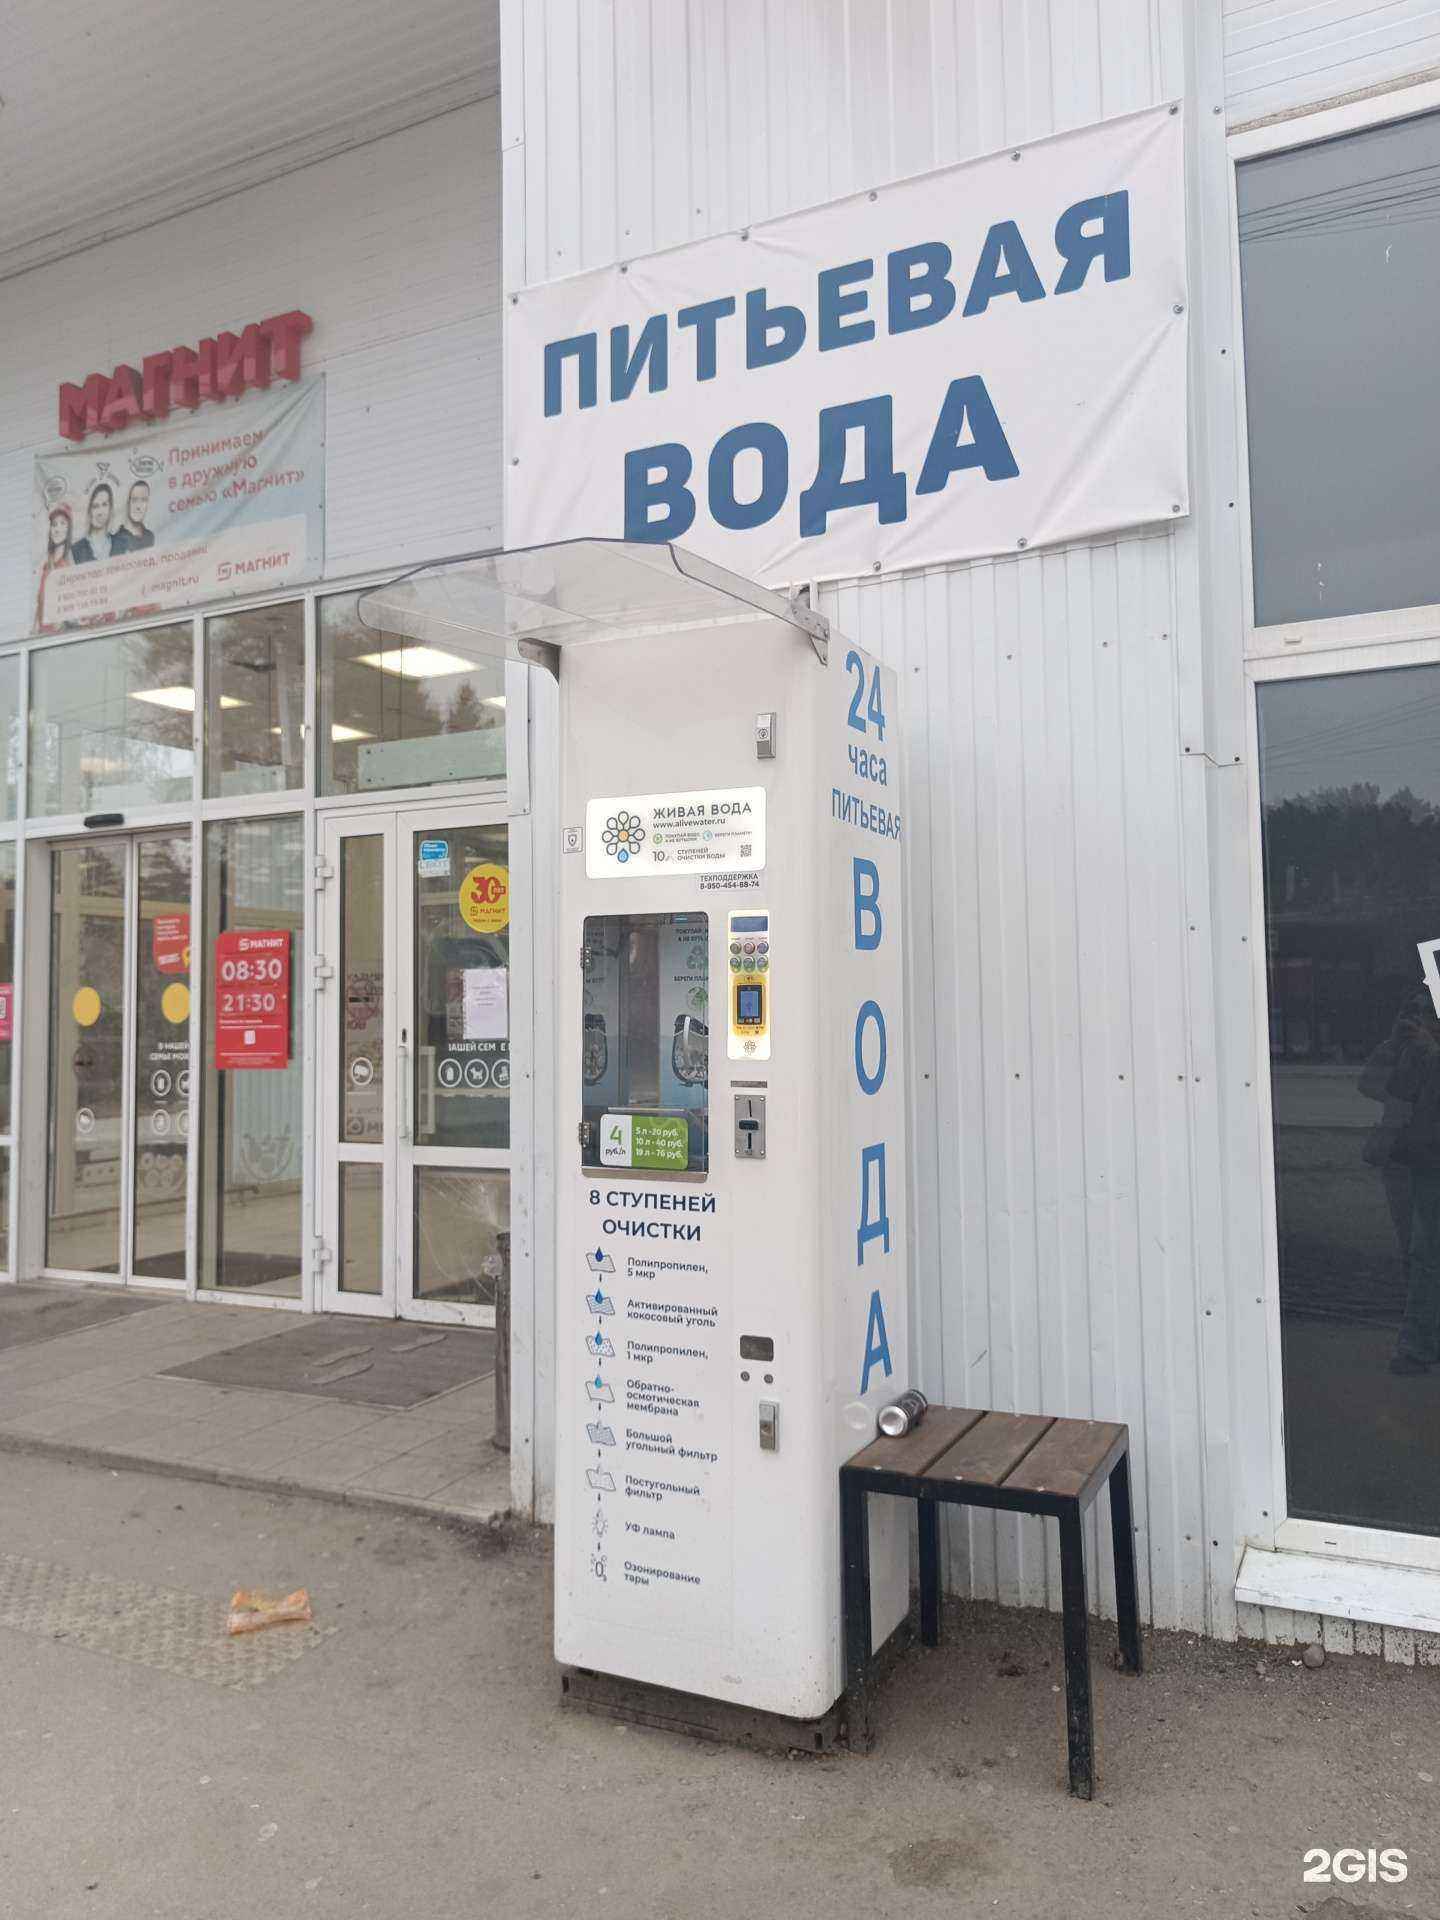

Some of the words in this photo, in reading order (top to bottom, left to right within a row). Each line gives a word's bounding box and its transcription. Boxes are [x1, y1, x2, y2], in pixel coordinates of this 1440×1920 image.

[544, 190, 1131, 417] ПИТЬЕВАЯ
[59, 310, 314, 442] МАГНИТ
[169, 430, 267, 465] Принимаем
[624, 375, 1020, 544] ВОДА
[168, 477, 177, 489] в
[182, 455, 257, 487] дружную
[168, 490, 217, 513] семью
[222, 470, 305, 499] «Магнит»
[235, 552, 290, 577] МАГНИТ
[846, 650, 886, 741] 24
[848, 744, 888, 786] часа
[653, 806, 705, 819] ЖИВАЯ
[711, 803, 752, 815] ВОДА
[832, 788, 901, 841] ПИТЬЕВАЯ
[653, 818, 726, 829] www.alivewater.ru
[653, 851, 665, 862] 10
[677, 847, 708, 855] СТУПЕНЕЙ
[700, 873, 759, 882] ТЕХПОДДЕРЖКА
[471, 877, 501, 904] 30
[250, 938, 284, 948] МАГНИТ
[221, 958, 283, 981] 08:30
[223, 993, 276, 1012] 21:30
[610, 1126, 622, 1145] 4
[662, 1128, 678, 1137] руб.
[853, 857, 893, 1396] ВОДА
[667, 1140, 684, 1149] руб.
[666, 1150, 683, 1159] руб.
[589, 1190, 601, 1205] 8
[606, 1190, 717, 1213] СТУПЕНЕЙ
[602, 1219, 701, 1241] ОЧИСТКИ
[627, 1257, 709, 1274] Полипропилен,
[627, 1269, 633, 1277] 5
[635, 1271, 656, 1280] мкр
[627, 1300, 718, 1317] Активированный
[627, 1312, 683, 1324] кокосовый
[685, 1318, 716, 1328] уголь
[627, 1341, 709, 1360] Полипропилен,
[632, 1354, 654, 1364] мкр
[626, 1379, 674, 1393] Обратно-
[626, 1391, 700, 1407] осмотическая
[627, 1402, 679, 1416] мембрана
[626, 1428, 673, 1443] Большой
[626, 1441, 675, 1455] угольный
[678, 1446, 718, 1463] фильтр
[625, 1475, 700, 1495] Постугольный
[625, 1487, 663, 1501] фильтр
[625, 1521, 640, 1533] УФ
[643, 1526, 675, 1540] лампа
[624, 1561, 701, 1584] Озонирование
[624, 1573, 650, 1585] тары
